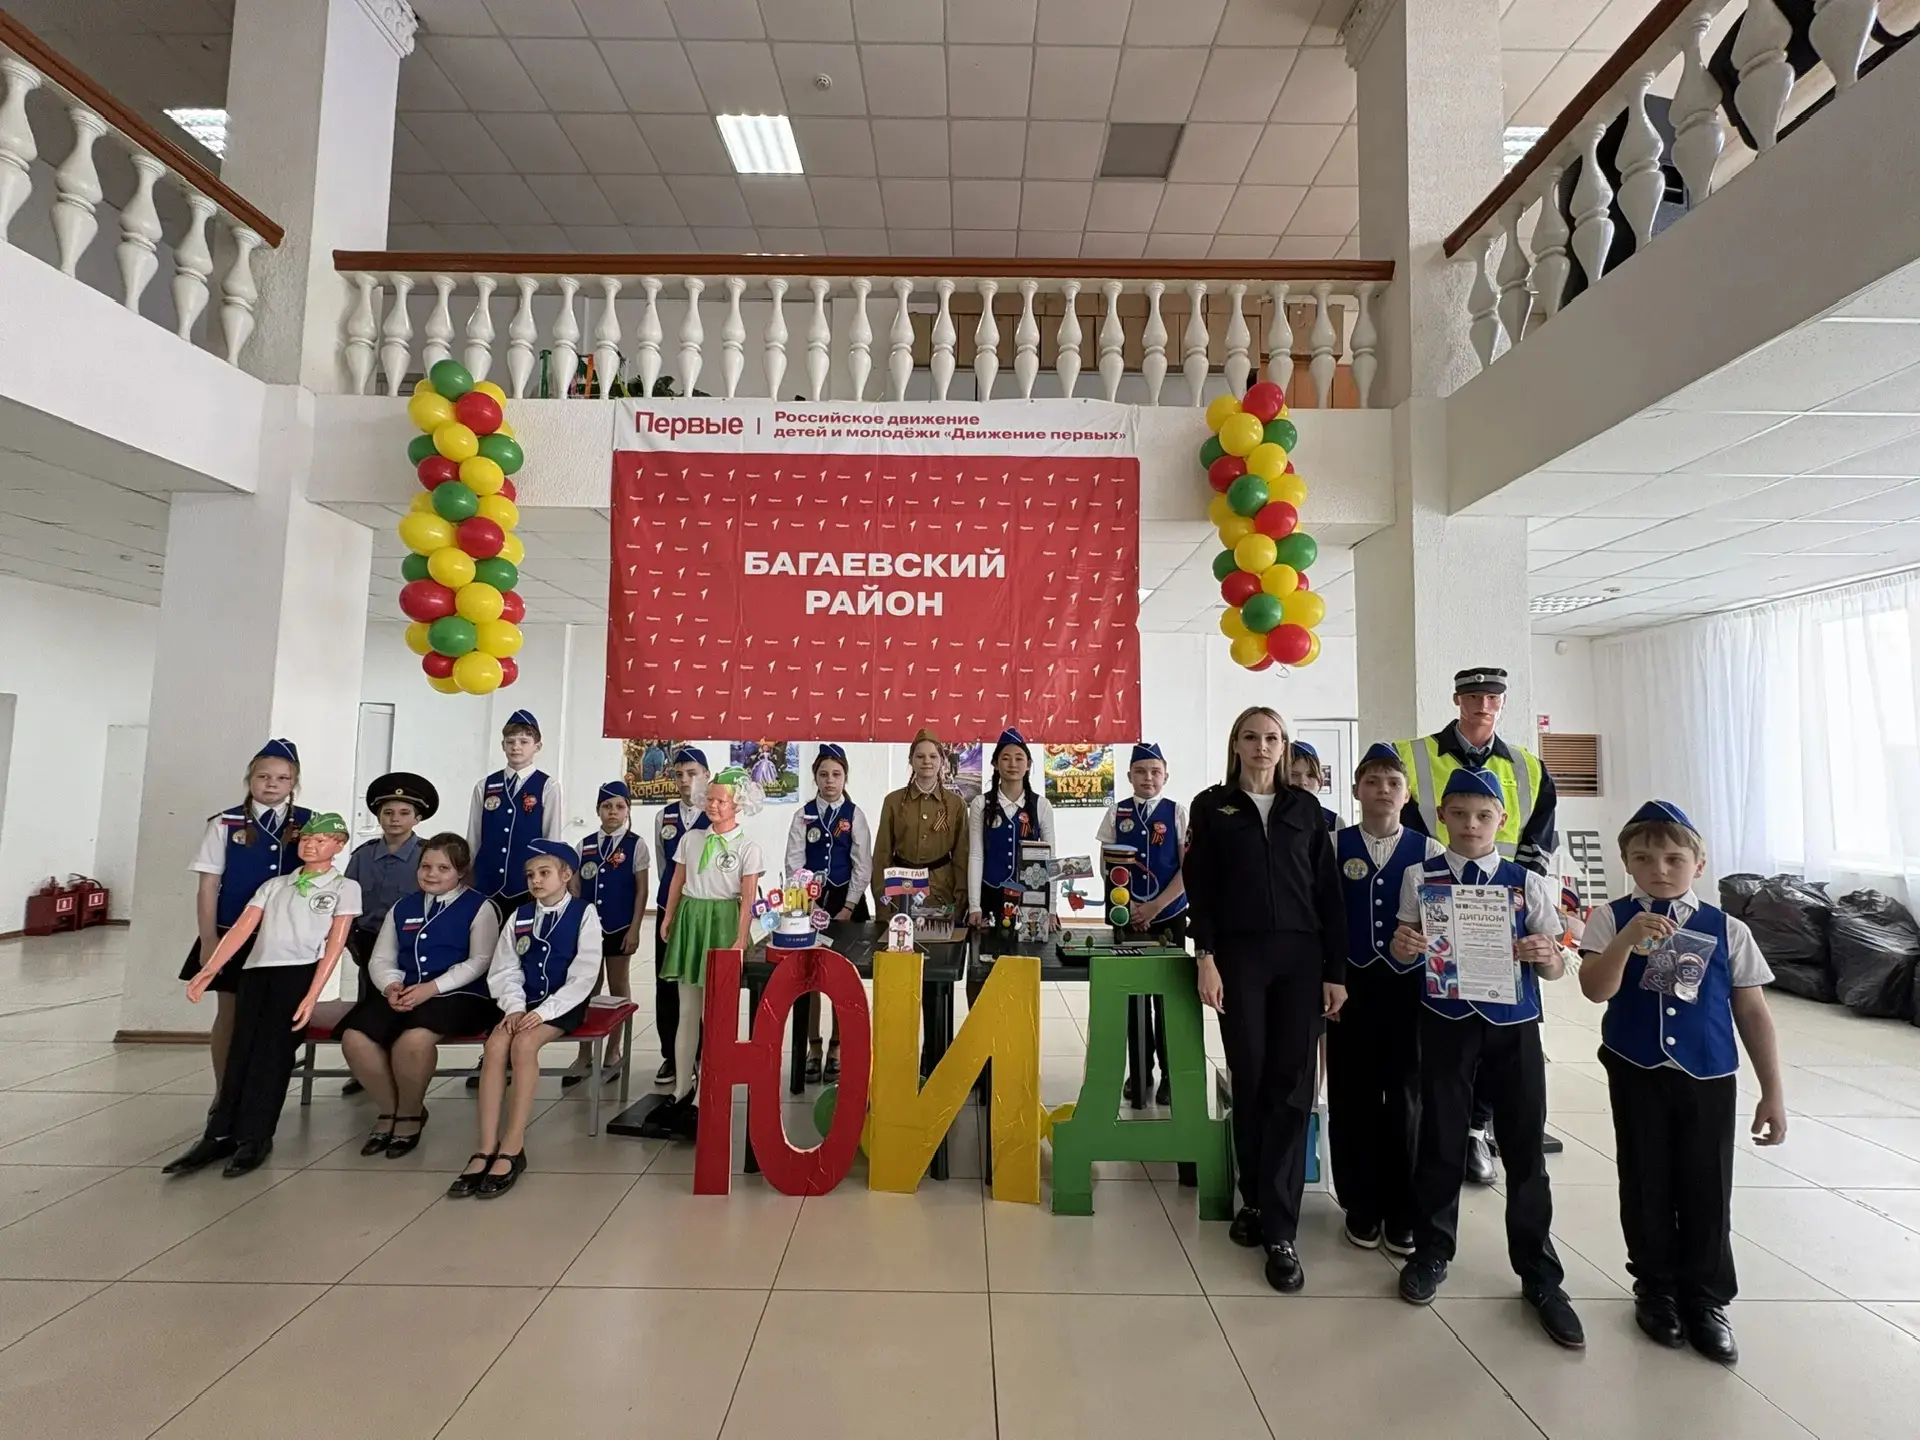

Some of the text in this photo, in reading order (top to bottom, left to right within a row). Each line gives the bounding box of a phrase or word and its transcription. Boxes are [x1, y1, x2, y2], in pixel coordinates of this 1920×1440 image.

[635, 411, 743, 441] Первые
[775, 411, 980, 426] Российское движение
[774, 427, 827, 438] детей
[846, 428, 940, 439] молодёжи
[944, 428, 1047, 441] «Движение
[1050, 431, 1126, 442] первых»
[744, 548, 1006, 579] БАГАЕВСКИЙ
[806, 584, 943, 616] РАЙОН
[1459, 913, 1505, 922] ДИПЛОМ
[694, 948, 1234, 1220] ЮИД
